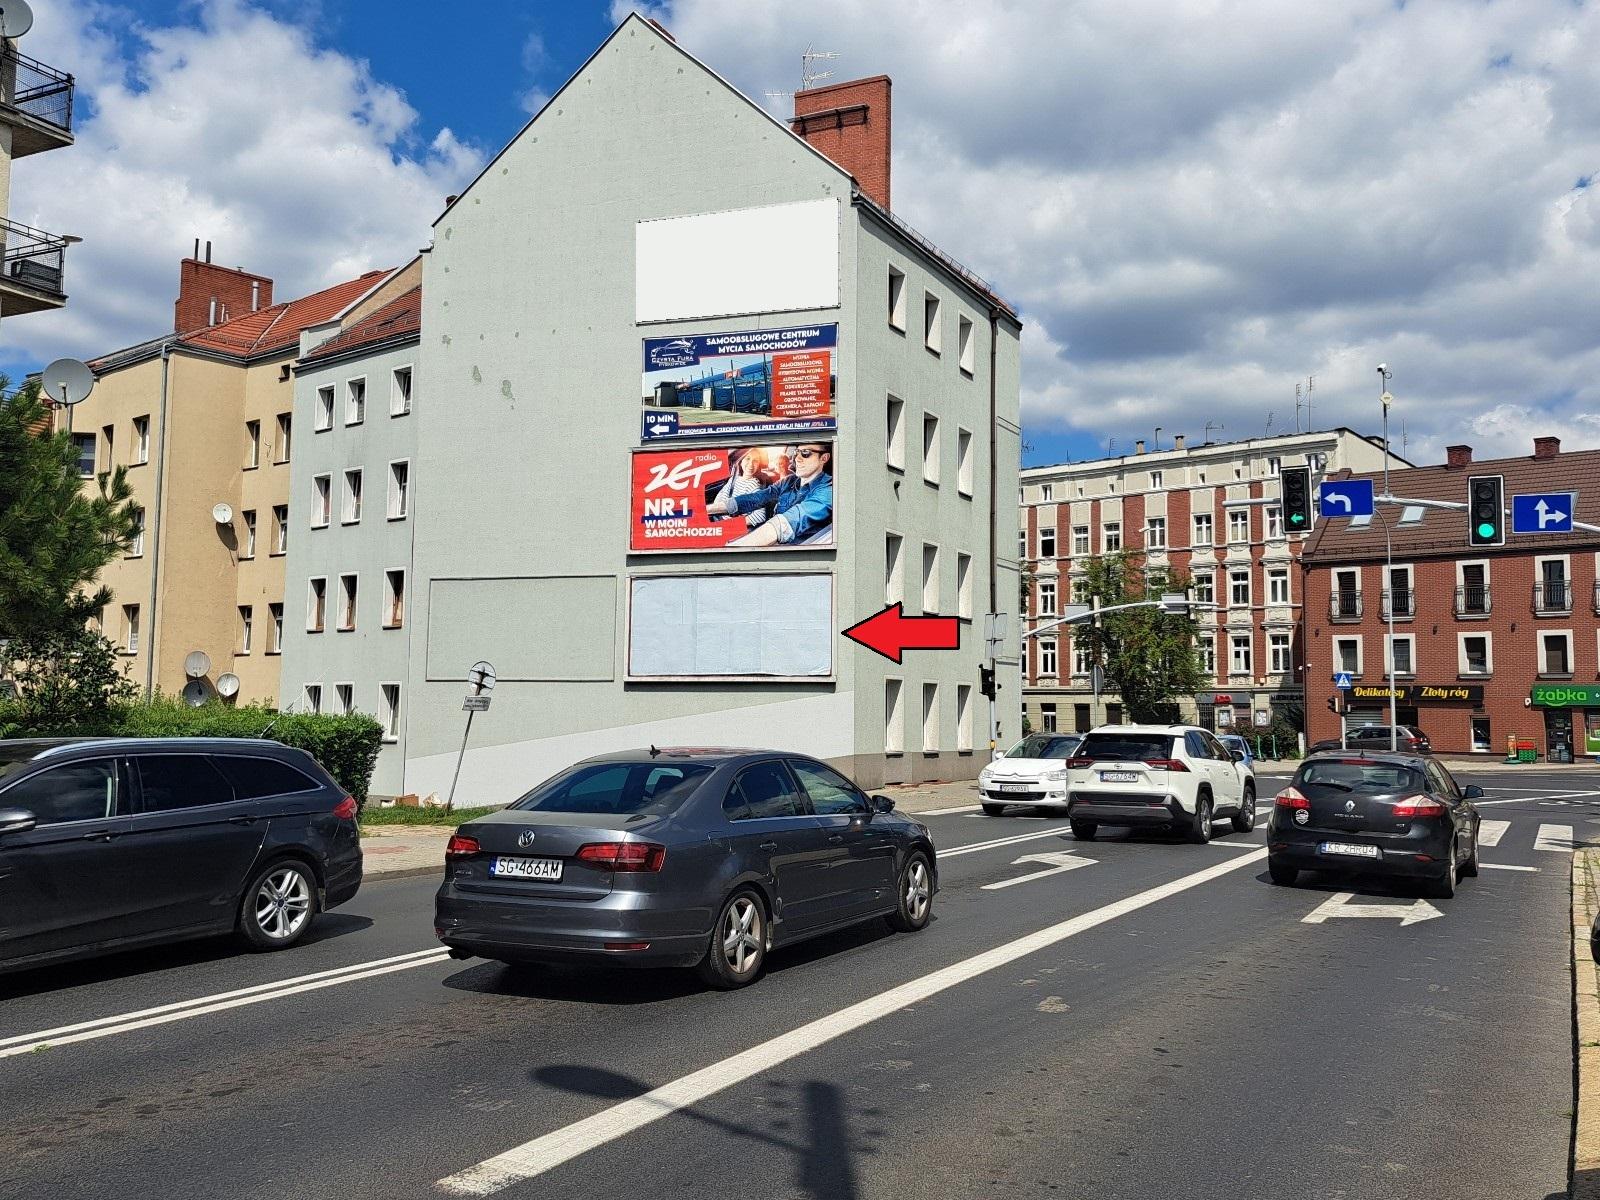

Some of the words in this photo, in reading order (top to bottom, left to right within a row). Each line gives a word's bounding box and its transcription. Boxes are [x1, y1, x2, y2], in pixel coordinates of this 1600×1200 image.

[706, 332, 779, 345] SAMOOBSŁUGOWE
[782, 329, 820, 340] CENTRUM
[718, 344, 744, 354] MYCIA
[746, 339, 806, 351] SAMOCHODÓW
[657, 415, 676, 423] MIN.
[695, 452, 717, 462] radio
[644, 459, 722, 493] ZET
[644, 498, 674, 516] NR
[679, 498, 688, 516] 1
[644, 520, 656, 528] W
[658, 519, 687, 528] MOIM
[644, 527, 722, 538] SAMOCHODZIE
[1421, 686, 1448, 699] Złoty
[1450, 687, 1469, 699] róg
[1536, 688, 1587, 700] żabka
[498, 858, 515, 874] SG
[519, 859, 559, 877] 466AM
